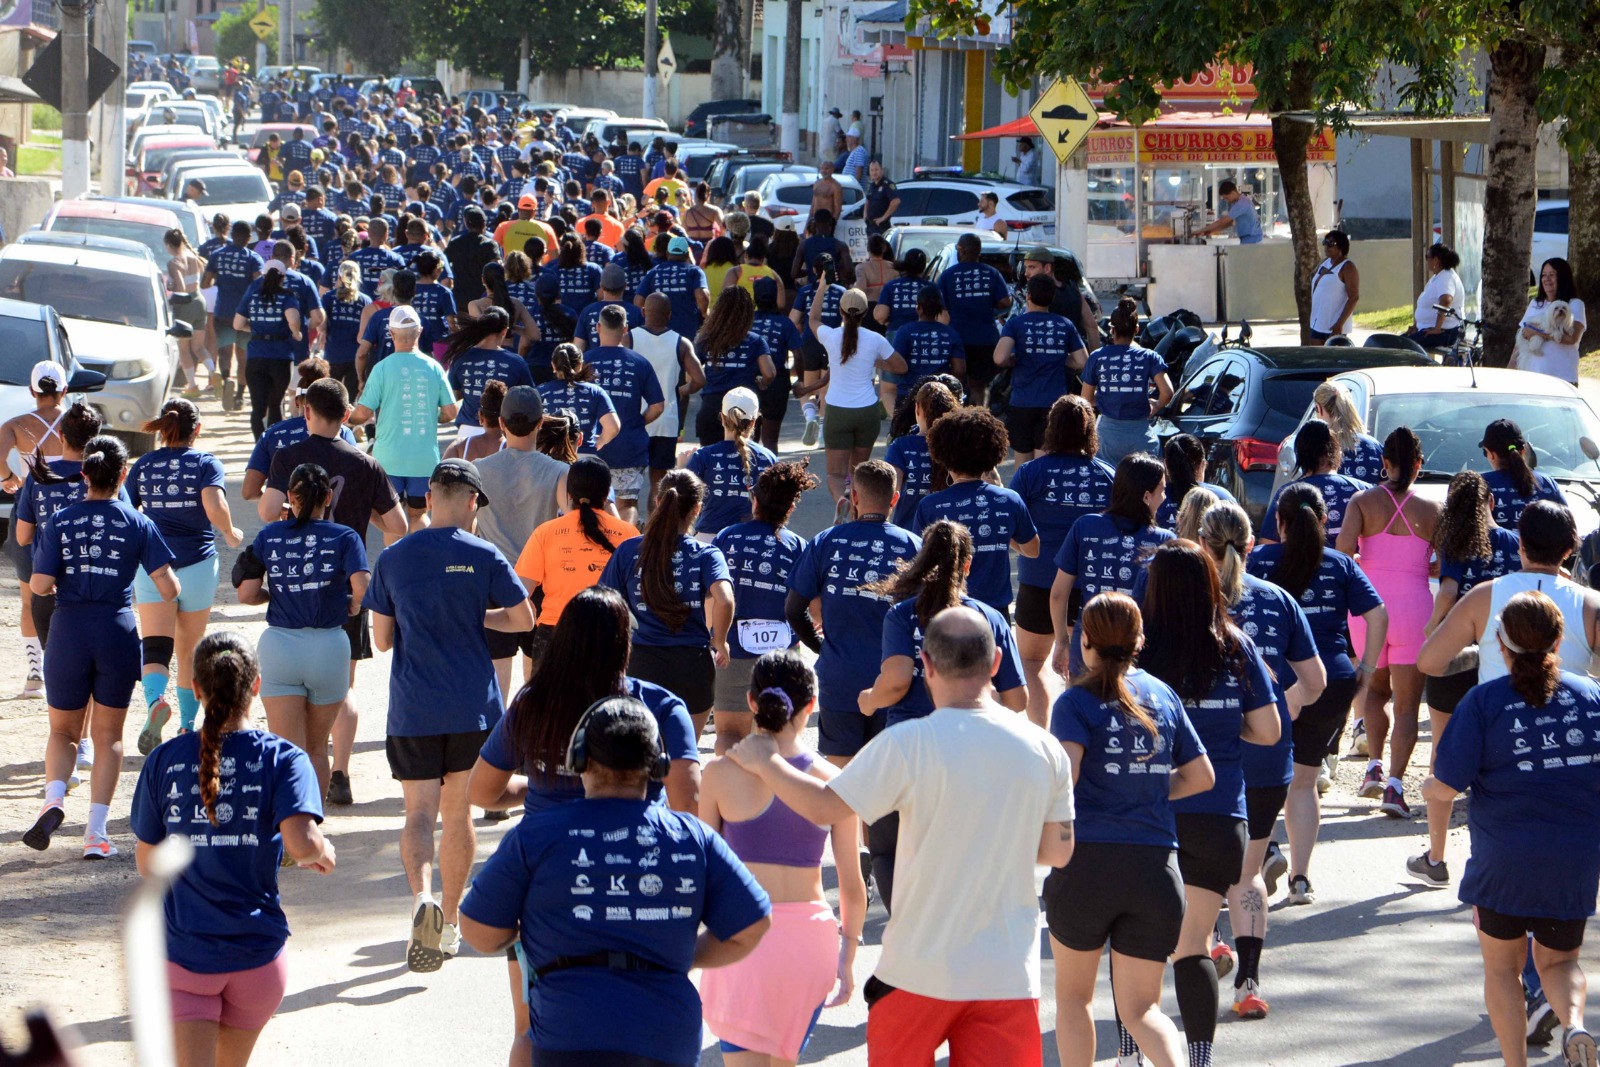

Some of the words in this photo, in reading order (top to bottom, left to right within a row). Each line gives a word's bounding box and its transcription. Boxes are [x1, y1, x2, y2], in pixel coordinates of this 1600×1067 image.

[1143, 132, 1243, 150] CHURROS
[1151, 153, 1184, 161] DOCE
[1187, 153, 1203, 161] DE
[1207, 153, 1239, 161] LEITE
[1244, 152, 1252, 160] E
[849, 239, 860, 247] DE
[752, 630, 778, 643] 107
[1134, 735, 1145, 749] LK
[1542, 731, 1556, 746] LK
[610, 874, 626, 891] LK
